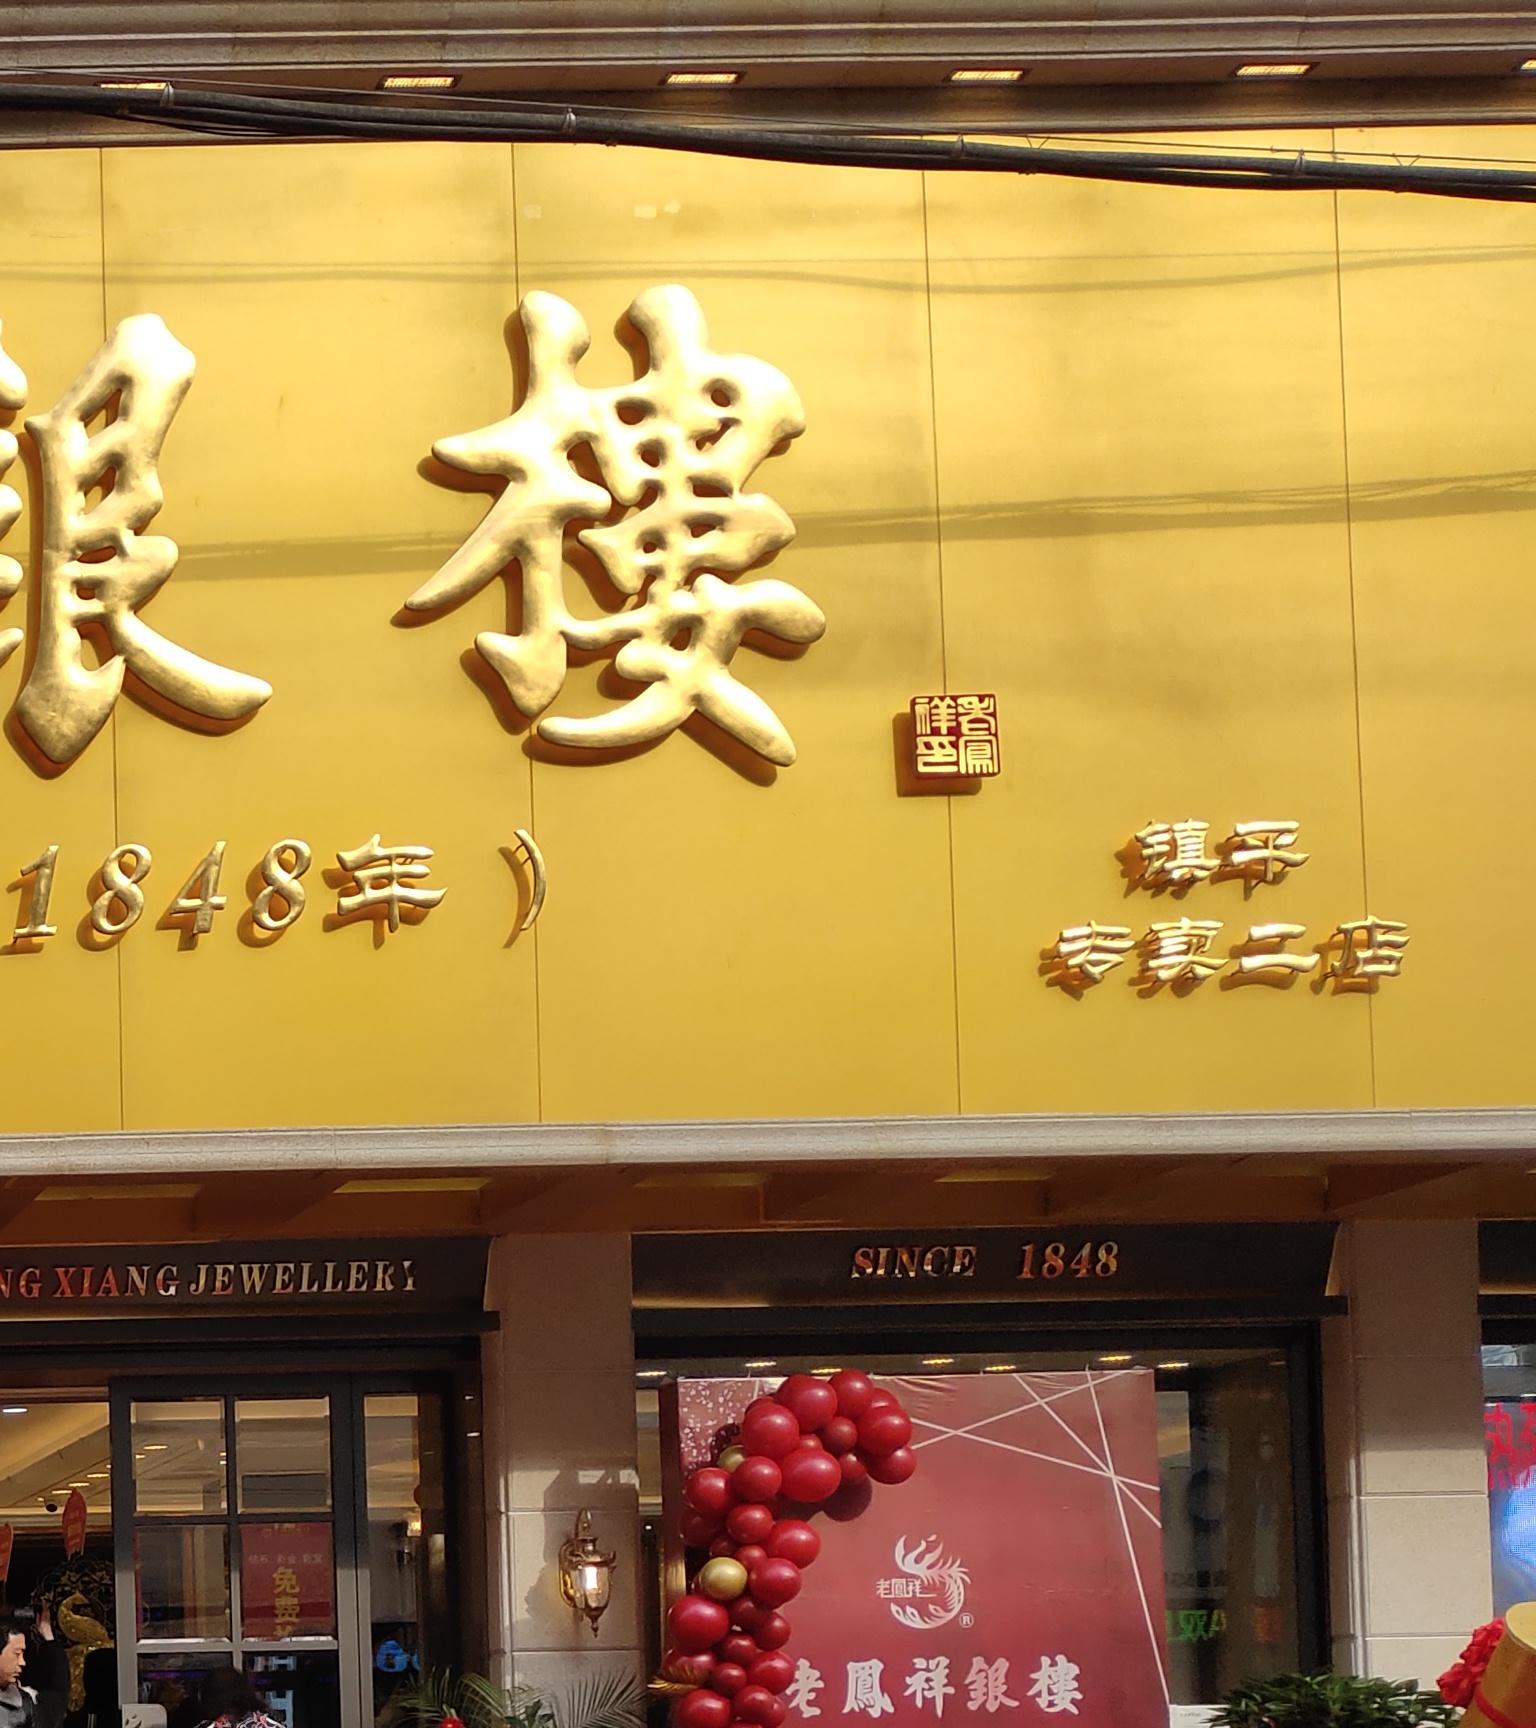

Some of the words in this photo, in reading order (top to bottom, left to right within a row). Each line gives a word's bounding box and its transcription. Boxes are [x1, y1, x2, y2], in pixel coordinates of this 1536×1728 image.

[1134, 818, 1311, 884] 镇平
[52, 1264, 180, 1297] XIANG
[189, 1261, 417, 1295] JEWELLERY
[850, 1245, 977, 1278] SINCE
[1015, 1241, 1120, 1279] 1848
